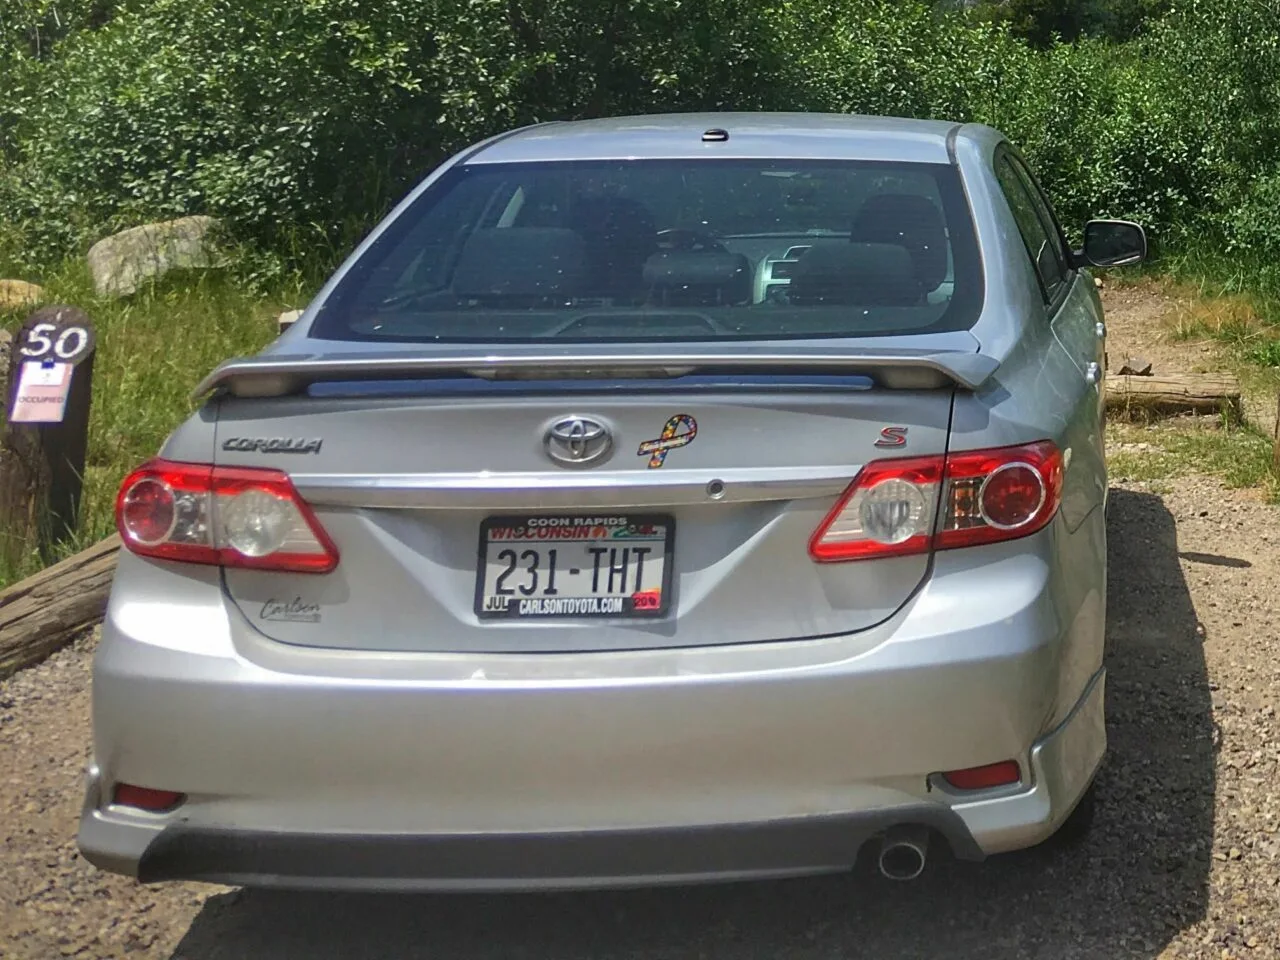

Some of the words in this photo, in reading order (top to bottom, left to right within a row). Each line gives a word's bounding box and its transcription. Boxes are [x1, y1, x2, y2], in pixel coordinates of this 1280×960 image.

[20, 323, 88, 358] 50
[18, 395, 65, 404] OCCUPIED
[222, 437, 324, 455] COROLLA
[873, 427, 909, 449] S
[527, 518, 571, 527] COON
[574, 517, 628, 526] RAPIDS
[491, 526, 590, 539] WISCONSIN
[495, 547, 652, 596] 231-THT
[486, 596, 509, 610] JUL
[519, 598, 623, 614] CARLSONTOYOTA.COM
